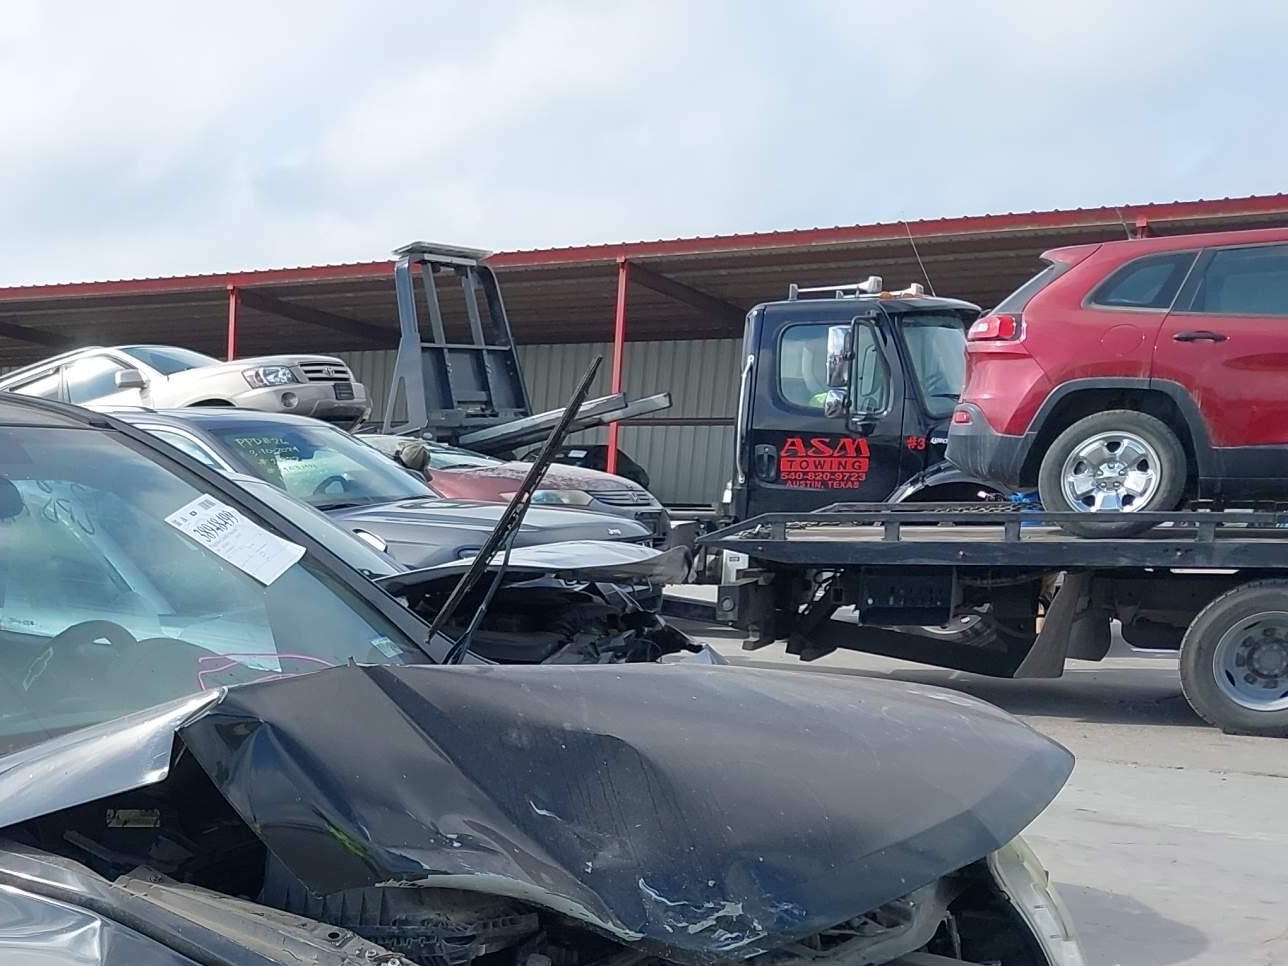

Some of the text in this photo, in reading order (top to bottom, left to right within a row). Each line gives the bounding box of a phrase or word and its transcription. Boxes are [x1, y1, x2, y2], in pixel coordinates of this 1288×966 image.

[779, 437, 870, 457] ASM
[906, 436, 926, 450] #3
[786, 458, 863, 471] TOWING
[828, 480, 859, 489] TEXAS
